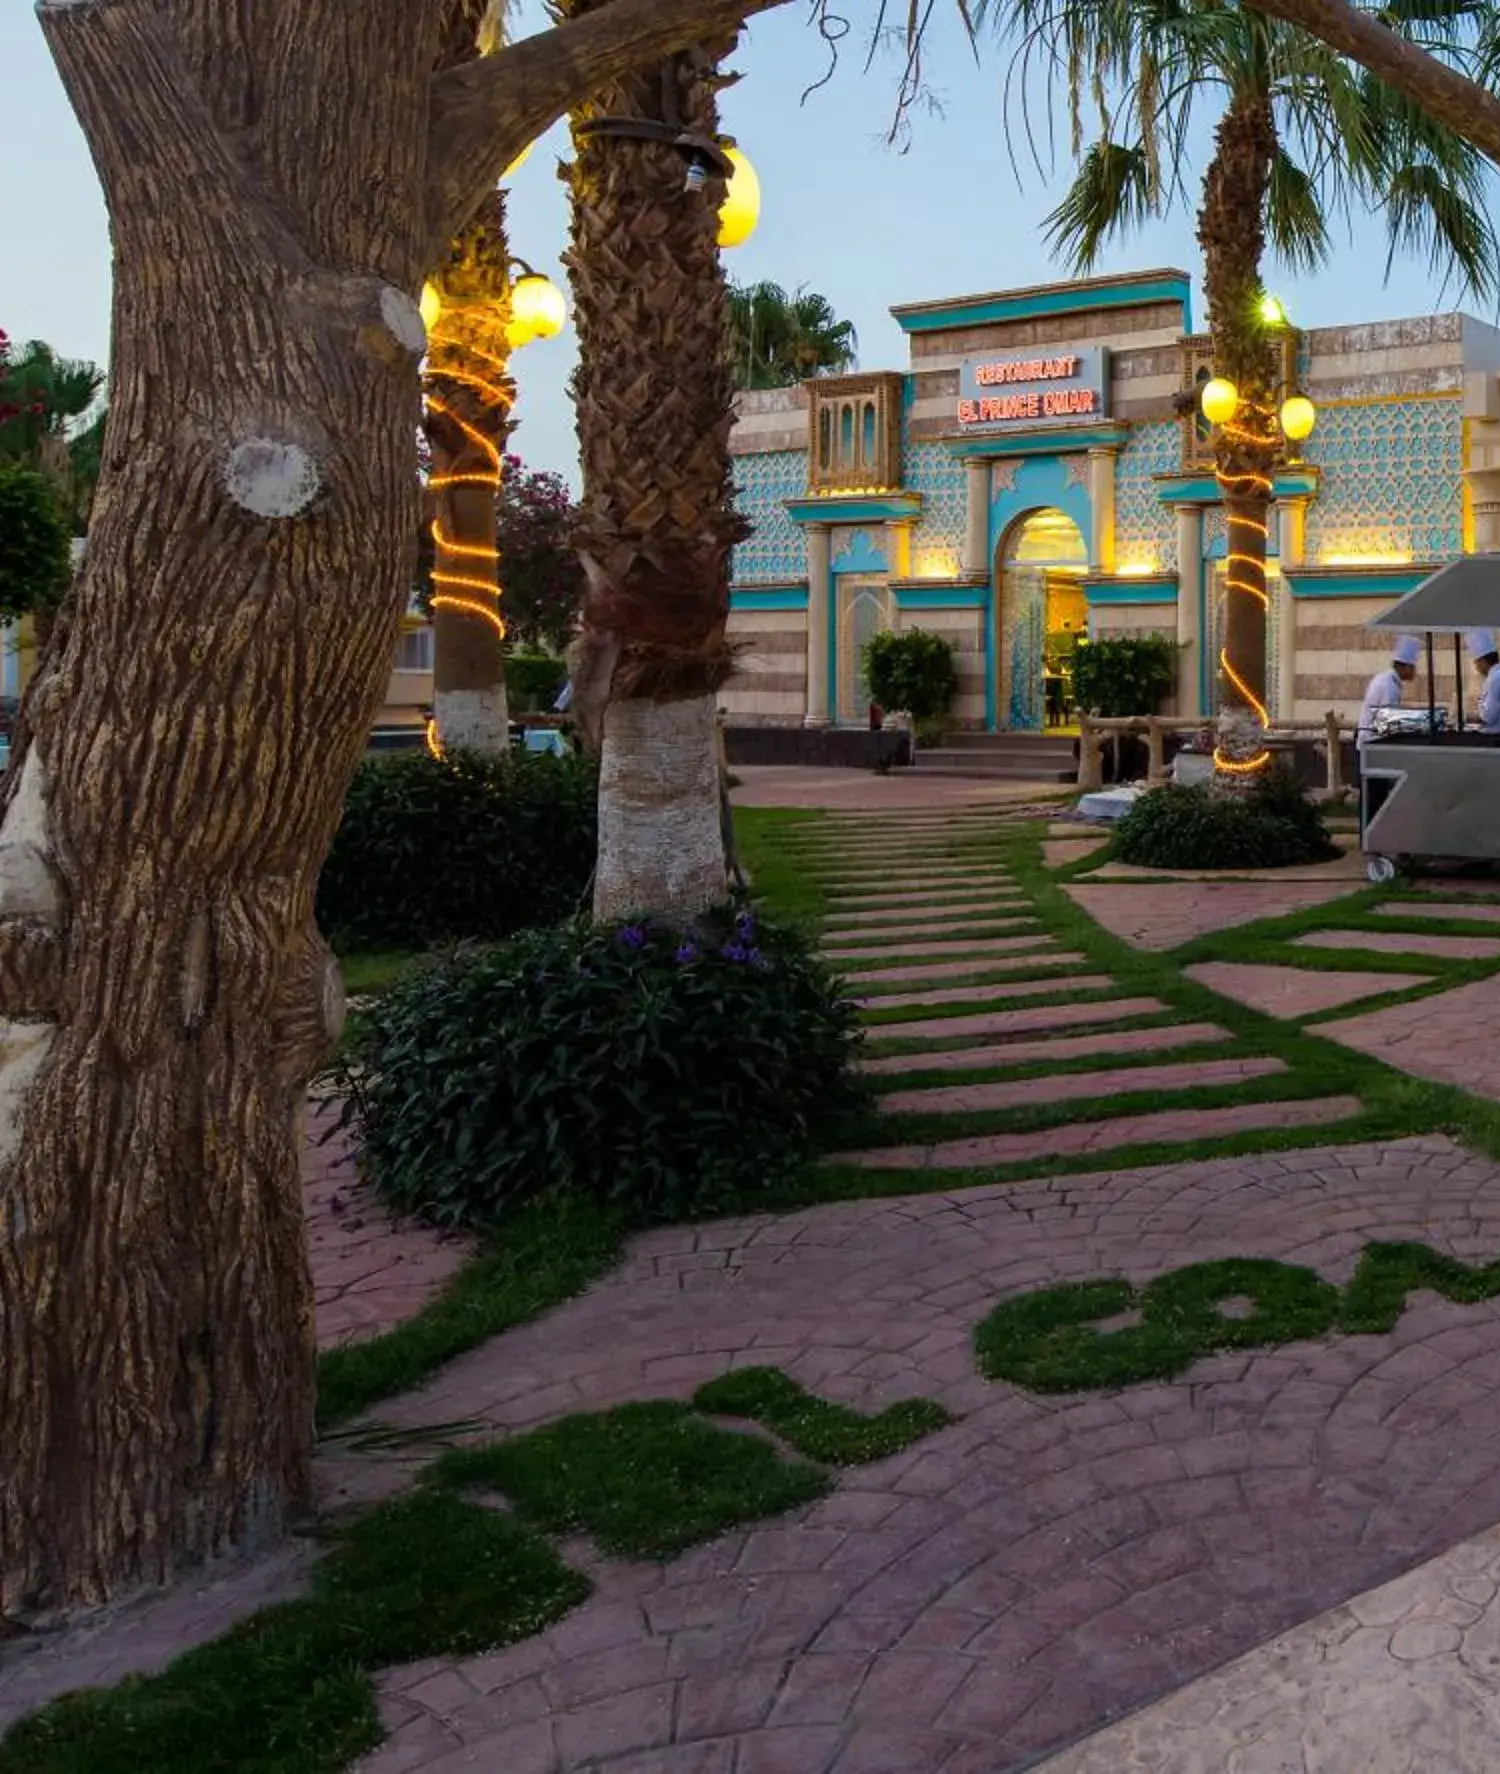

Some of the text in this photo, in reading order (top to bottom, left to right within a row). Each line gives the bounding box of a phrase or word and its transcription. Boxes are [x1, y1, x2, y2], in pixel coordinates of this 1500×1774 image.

[975, 354, 1077, 385] RESTAURANT
[958, 399, 979, 423] EL
[980, 393, 1039, 420] PRINCE
